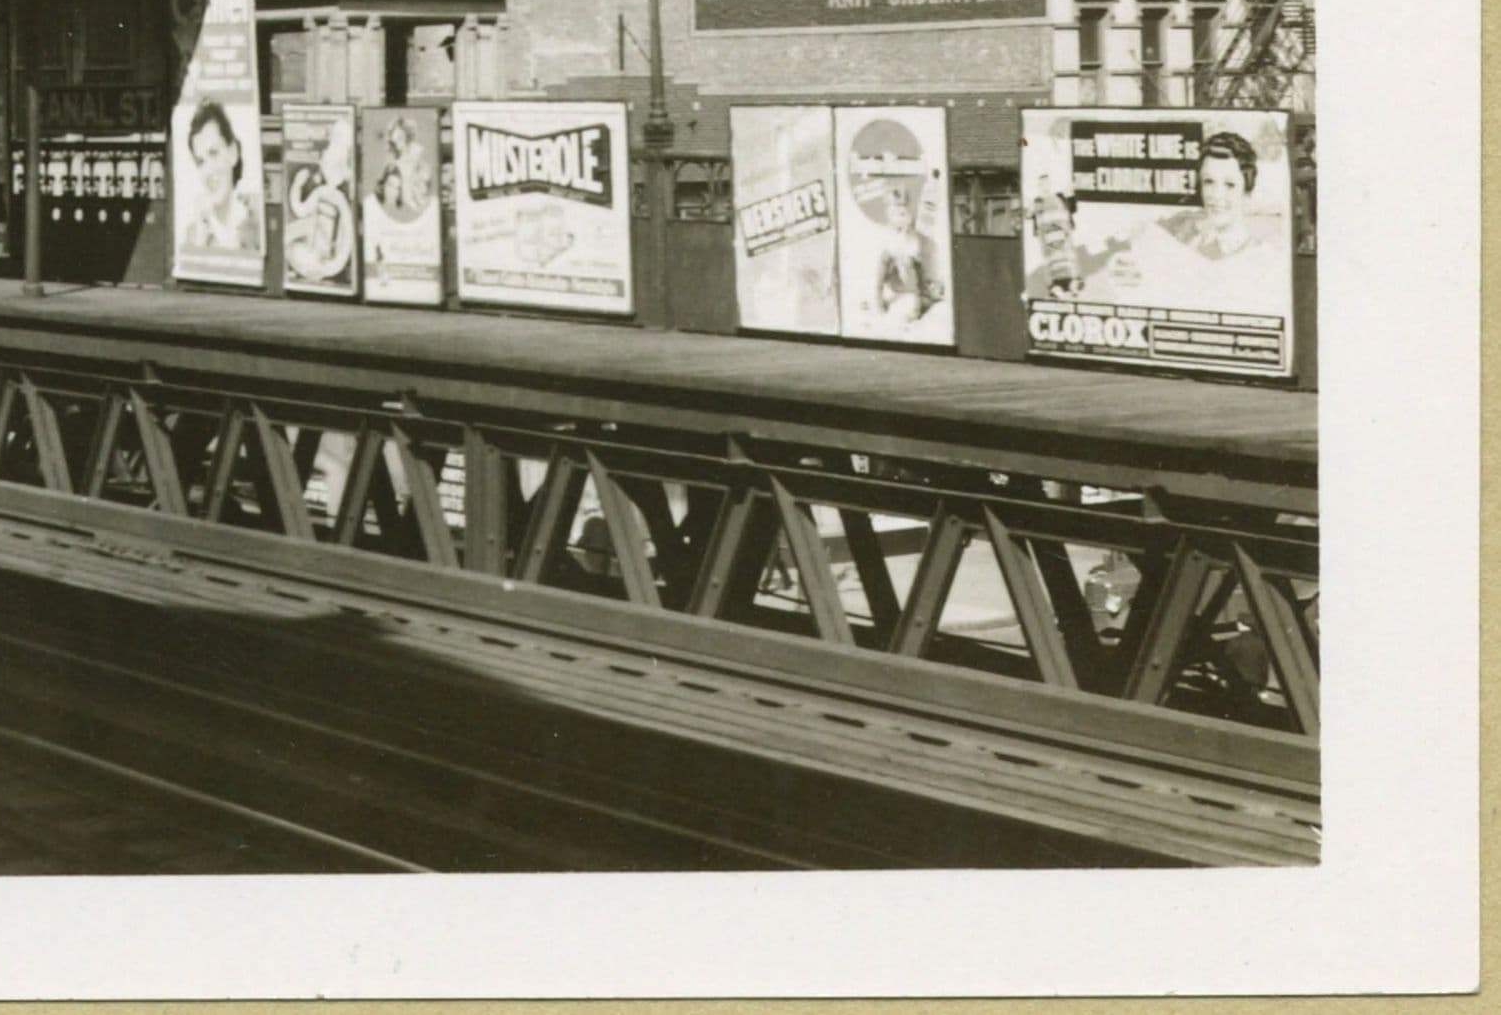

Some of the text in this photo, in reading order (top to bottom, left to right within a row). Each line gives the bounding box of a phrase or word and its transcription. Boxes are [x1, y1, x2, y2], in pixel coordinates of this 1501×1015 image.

[468, 126, 604, 194] MUSTEROLE
[1095, 133, 1146, 158] WHITE
[1028, 311, 1149, 349] CLOROX
